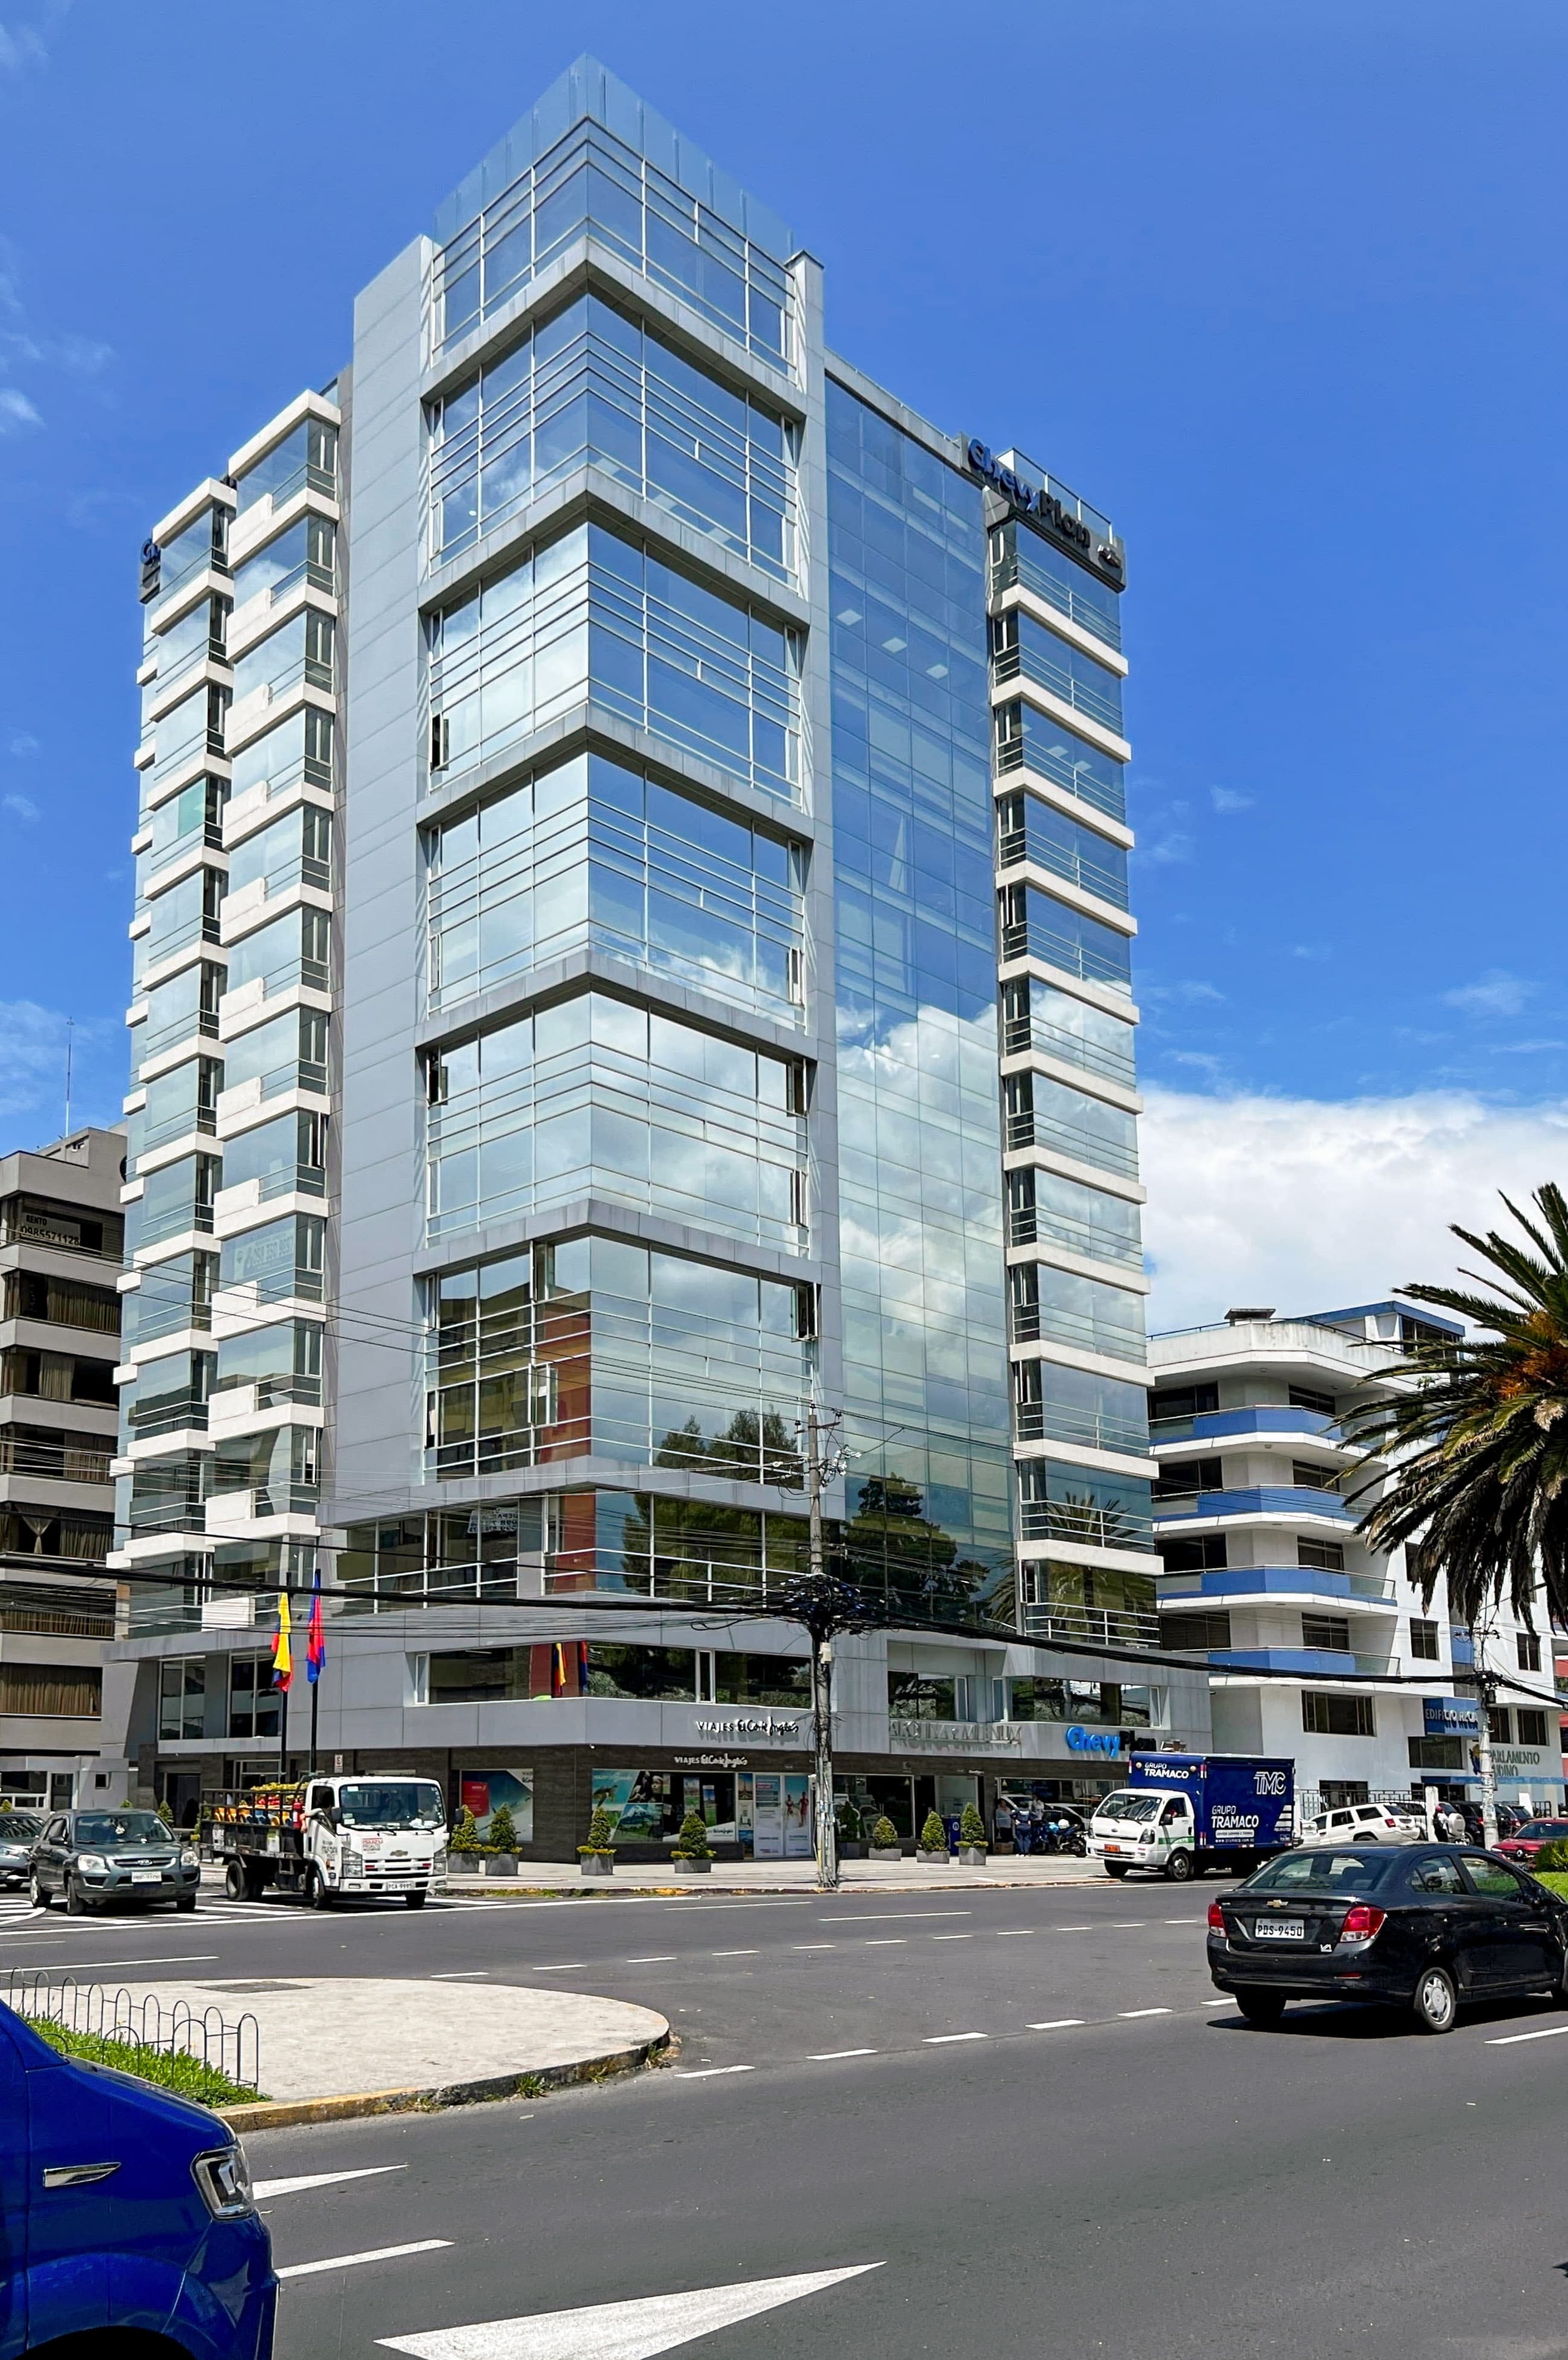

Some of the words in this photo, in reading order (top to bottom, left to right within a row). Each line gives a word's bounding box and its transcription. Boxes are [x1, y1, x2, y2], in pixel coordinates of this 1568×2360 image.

[1425, 1708, 1457, 1721] EDIFICIO
[696, 1721, 735, 1733] VIAJES
[674, 1756, 700, 1765] VIAJES
[1144, 1768, 1190, 1779] TRAMACO
[1254, 1772, 1286, 1795] TMC
[1211, 1805, 1236, 1814] GRUPO
[1211, 1815, 1259, 1828] TRAMACO
